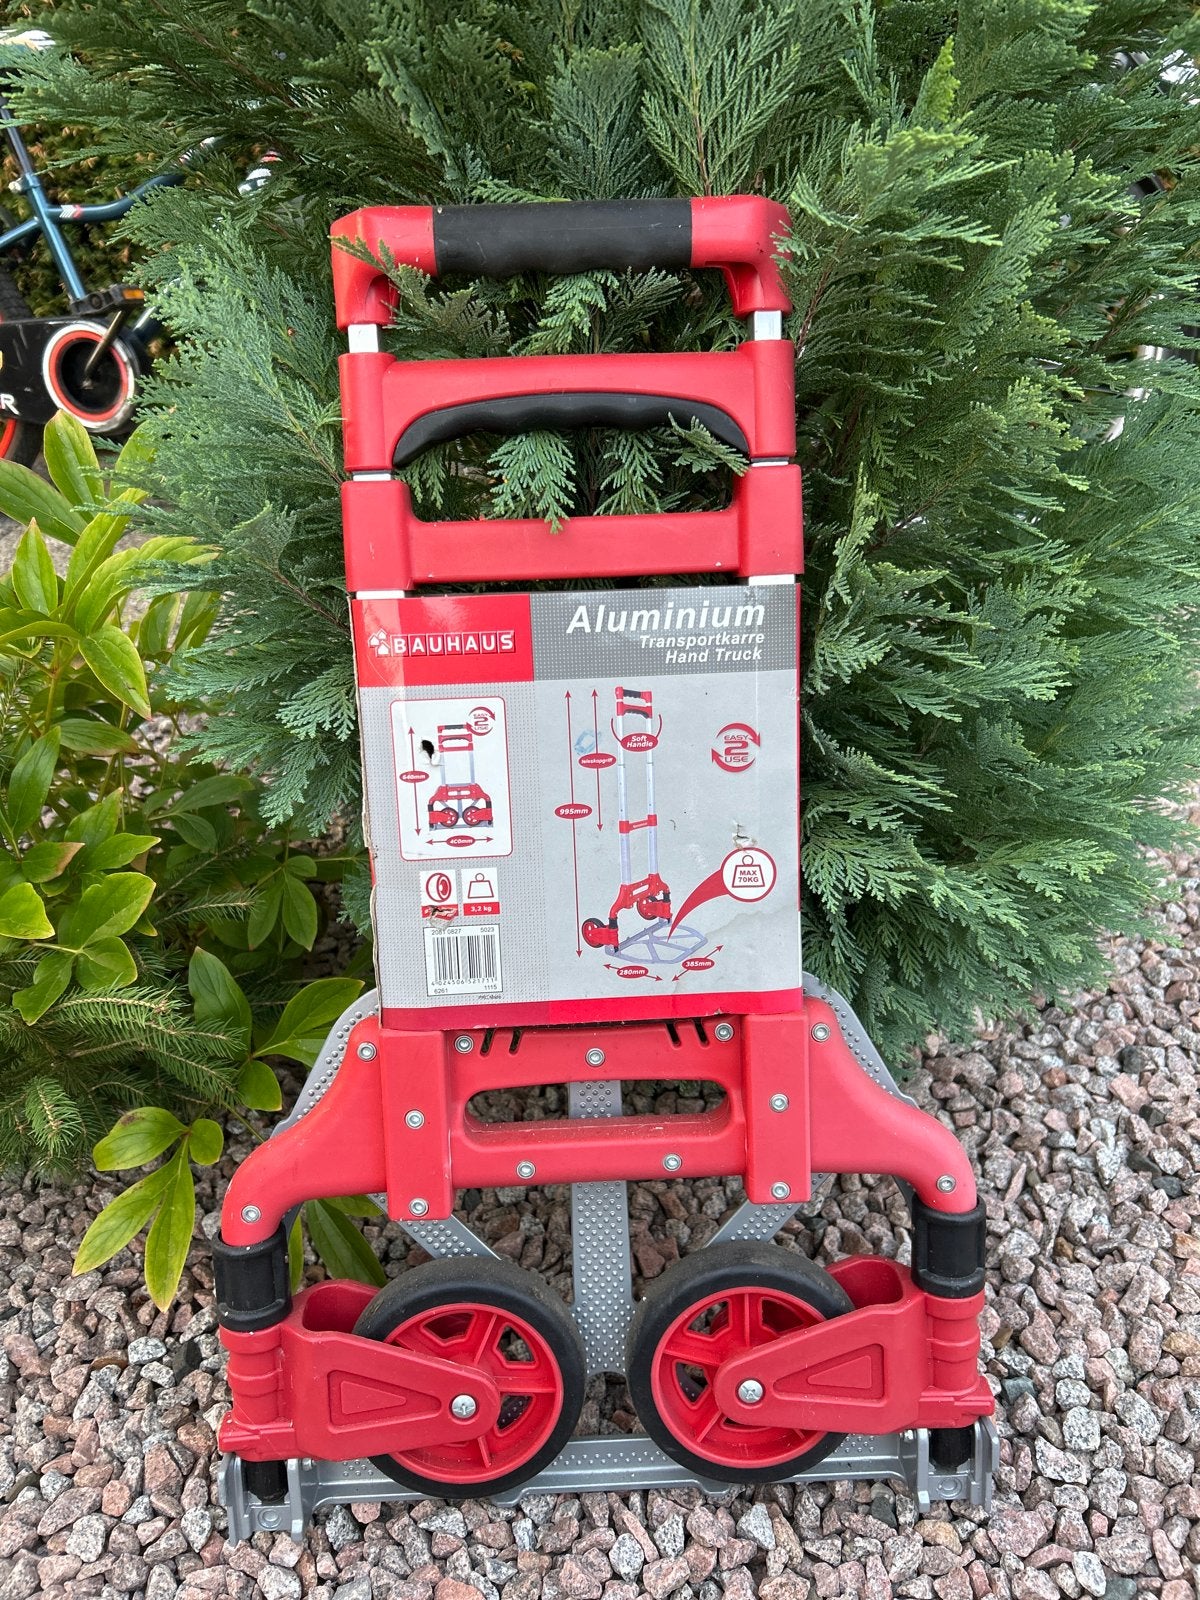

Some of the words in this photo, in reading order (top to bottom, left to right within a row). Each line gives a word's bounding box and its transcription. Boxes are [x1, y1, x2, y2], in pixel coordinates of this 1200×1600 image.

[0, 393, 20, 415] R
[566, 601, 766, 634] Aluminium
[392, 634, 515, 655] BAUHAUS
[640, 631, 765, 650] Transportkarre
[665, 648, 708, 664] Hand
[715, 646, 763, 662] Truck
[631, 734, 647, 742] Soft
[626, 740, 653, 748] Handle
[724, 740, 749, 755] 2
[724, 755, 749, 763] USE
[559, 807, 589, 815] 995mm
[470, 905, 482, 913] 3,2
[685, 960, 712, 968] 385mm
[619, 968, 646, 976] 280mm
